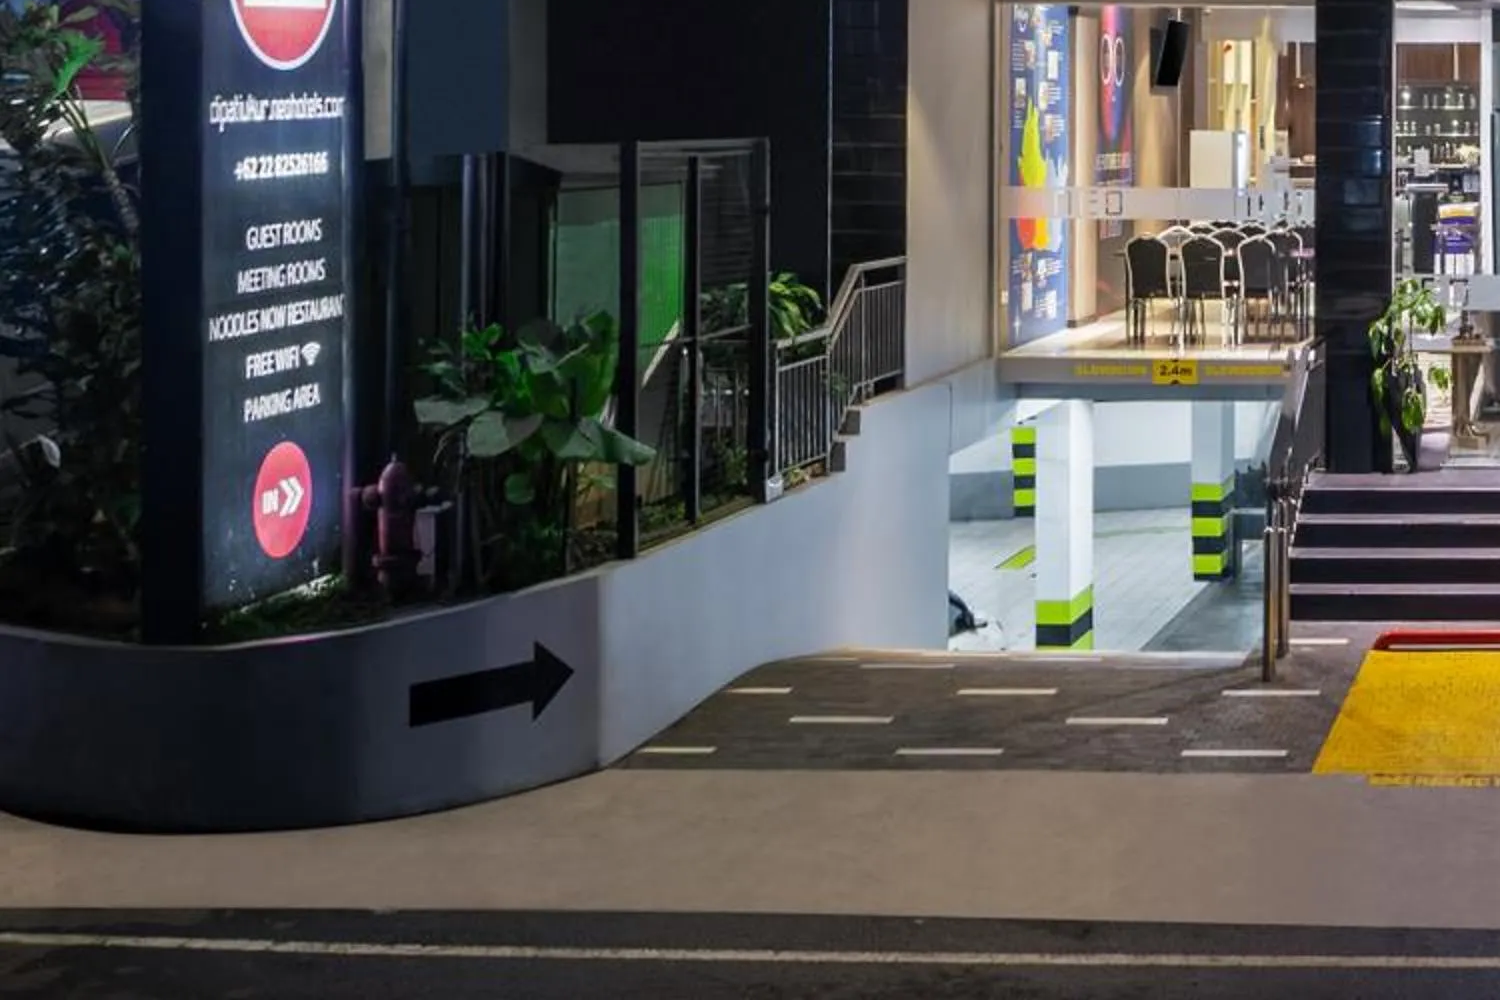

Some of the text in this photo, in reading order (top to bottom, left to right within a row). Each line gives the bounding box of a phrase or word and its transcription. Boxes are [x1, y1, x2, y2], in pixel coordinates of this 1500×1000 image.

[245, 217, 323, 251] GUEST ROOMS
[237, 257, 326, 294] MEETING ROOMS
[209, 308, 260, 342] NOODLES
[287, 294, 345, 327] RESTAURAN
[246, 351, 276, 379] FREE
[244, 382, 321, 423] PARKING AREA
